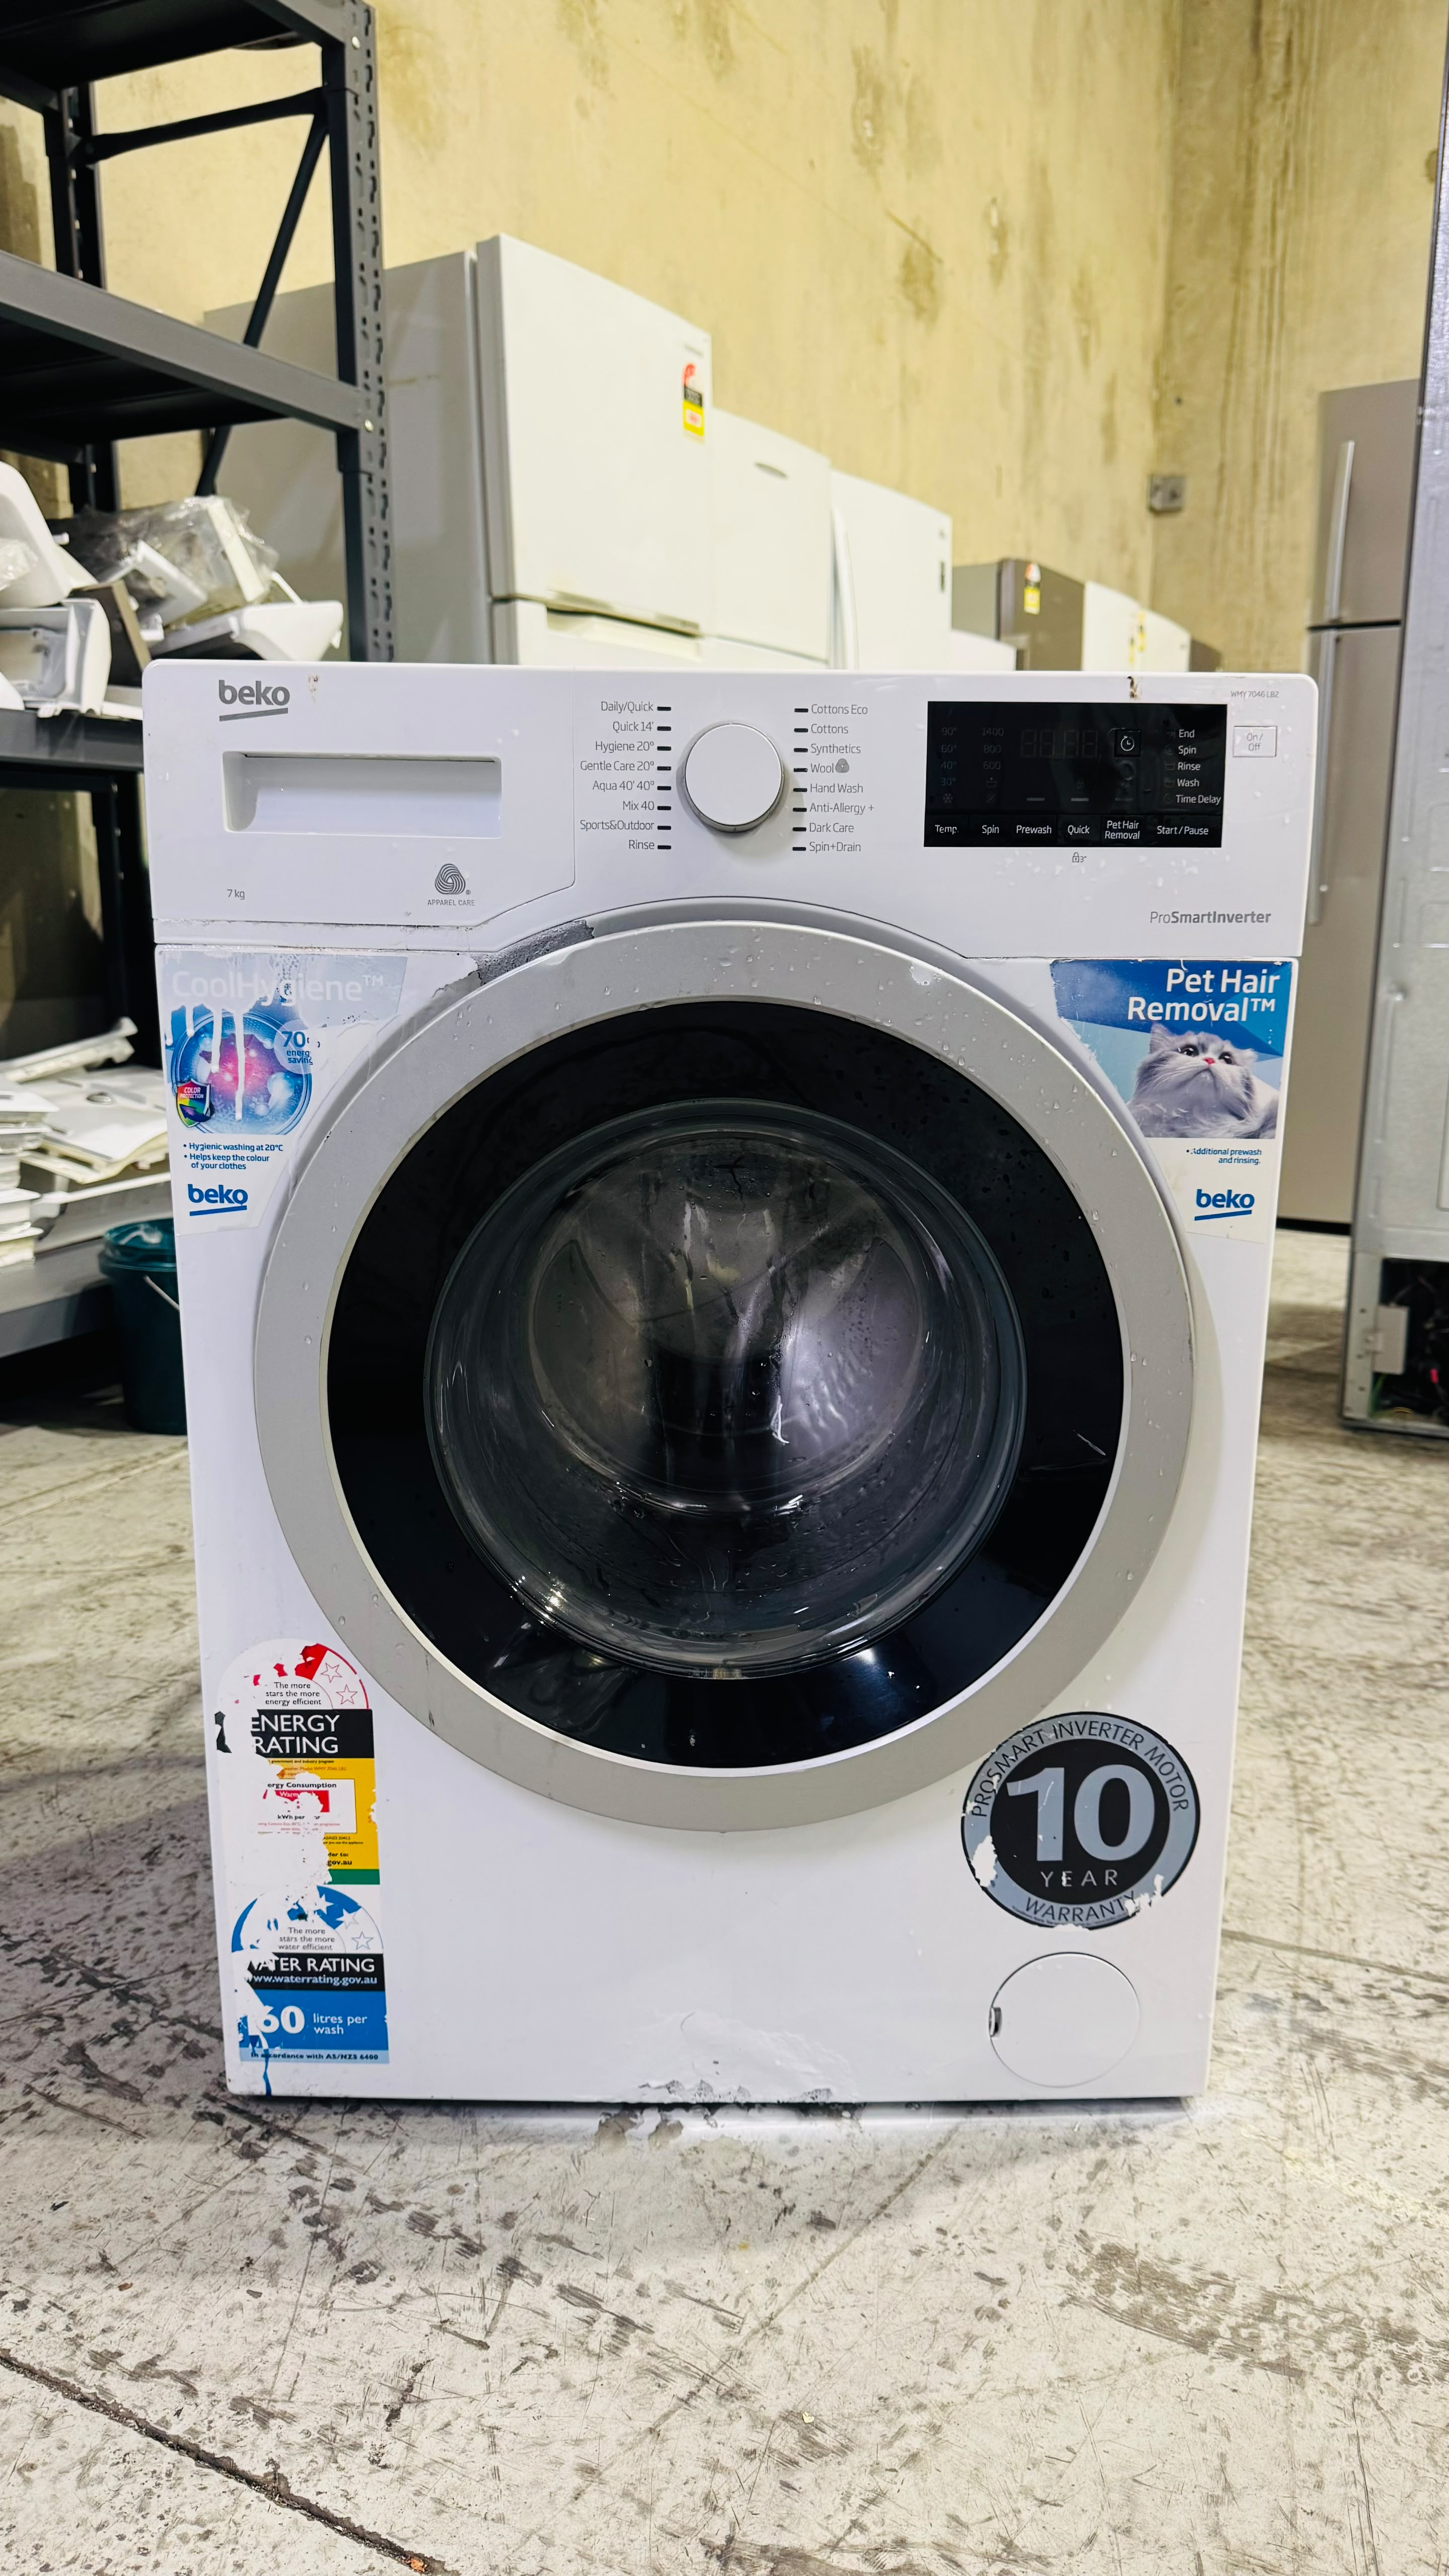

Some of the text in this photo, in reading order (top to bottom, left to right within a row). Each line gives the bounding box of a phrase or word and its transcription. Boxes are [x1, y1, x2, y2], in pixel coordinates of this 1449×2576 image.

[219, 680, 290, 706] beko
[601, 701, 654, 713] Daily/Quick
[811, 705, 868, 715] Cottons Eco
[613, 721, 639, 733] Quick
[811, 724, 849, 735] Cottons
[1178, 729, 1195, 739] End
[595, 741, 635, 753] Hygiene
[811, 744, 861, 755] Synthetics
[1178, 745, 1196, 756] Spin
[1248, 743, 1261, 752] Off
[580, 761, 611, 771] Gentle
[613, 761, 635, 771] Care
[810, 763, 834, 774] Wool
[1177, 762, 1201, 772] Rinse
[592, 781, 617, 792] Aqua
[810, 783, 863, 793] Hand Wash
[1177, 778, 1200, 788] Wash
[622, 800, 655, 811] Mix 40
[1176, 794, 1221, 807] Time Delay
[809, 802, 866, 815] Anti-Allergy
[580, 820, 655, 832] Sports&Outdoor
[809, 823, 854, 833] Dark Care
[982, 824, 1000, 836] Spin
[1016, 825, 1052, 835] Prewash
[1067, 825, 1090, 836] Quick
[1107, 820, 1139, 830] Pet Hair
[1104, 830, 1140, 841] Removal
[628, 840, 655, 850] Rinse
[809, 842, 862, 853] Spin+Drain
[226, 889, 245, 901] 7 kg
[1150, 911, 1272, 925] ProSmartInverter
[1166, 967, 1281, 994] Pet Hair
[286, 1050, 311, 1058] energ
[189, 1143, 222, 1153] Hygienic
[223, 1144, 255, 1153] washing
[190, 1153, 211, 1162] Helps
[212, 1154, 231, 1163] keep
[246, 1154, 269, 1162] colour
[187, 1184, 248, 1205] beko
[1195, 1188, 1255, 1209] beko
[251, 1714, 340, 1732] ENERGY
[254, 1736, 339, 1754] RATING
[971, 1720, 1189, 1818] PROSMART INVERTER MOTOR
[1006, 1763, 1156, 1862] 10
[1040, 1869, 1118, 1888] YEAR
[1025, 1890, 1136, 1922] WARRANTY
[306, 1958, 375, 1973] RATING
[313, 2013, 368, 2027] litres per
[314, 2025, 344, 2035] wash
